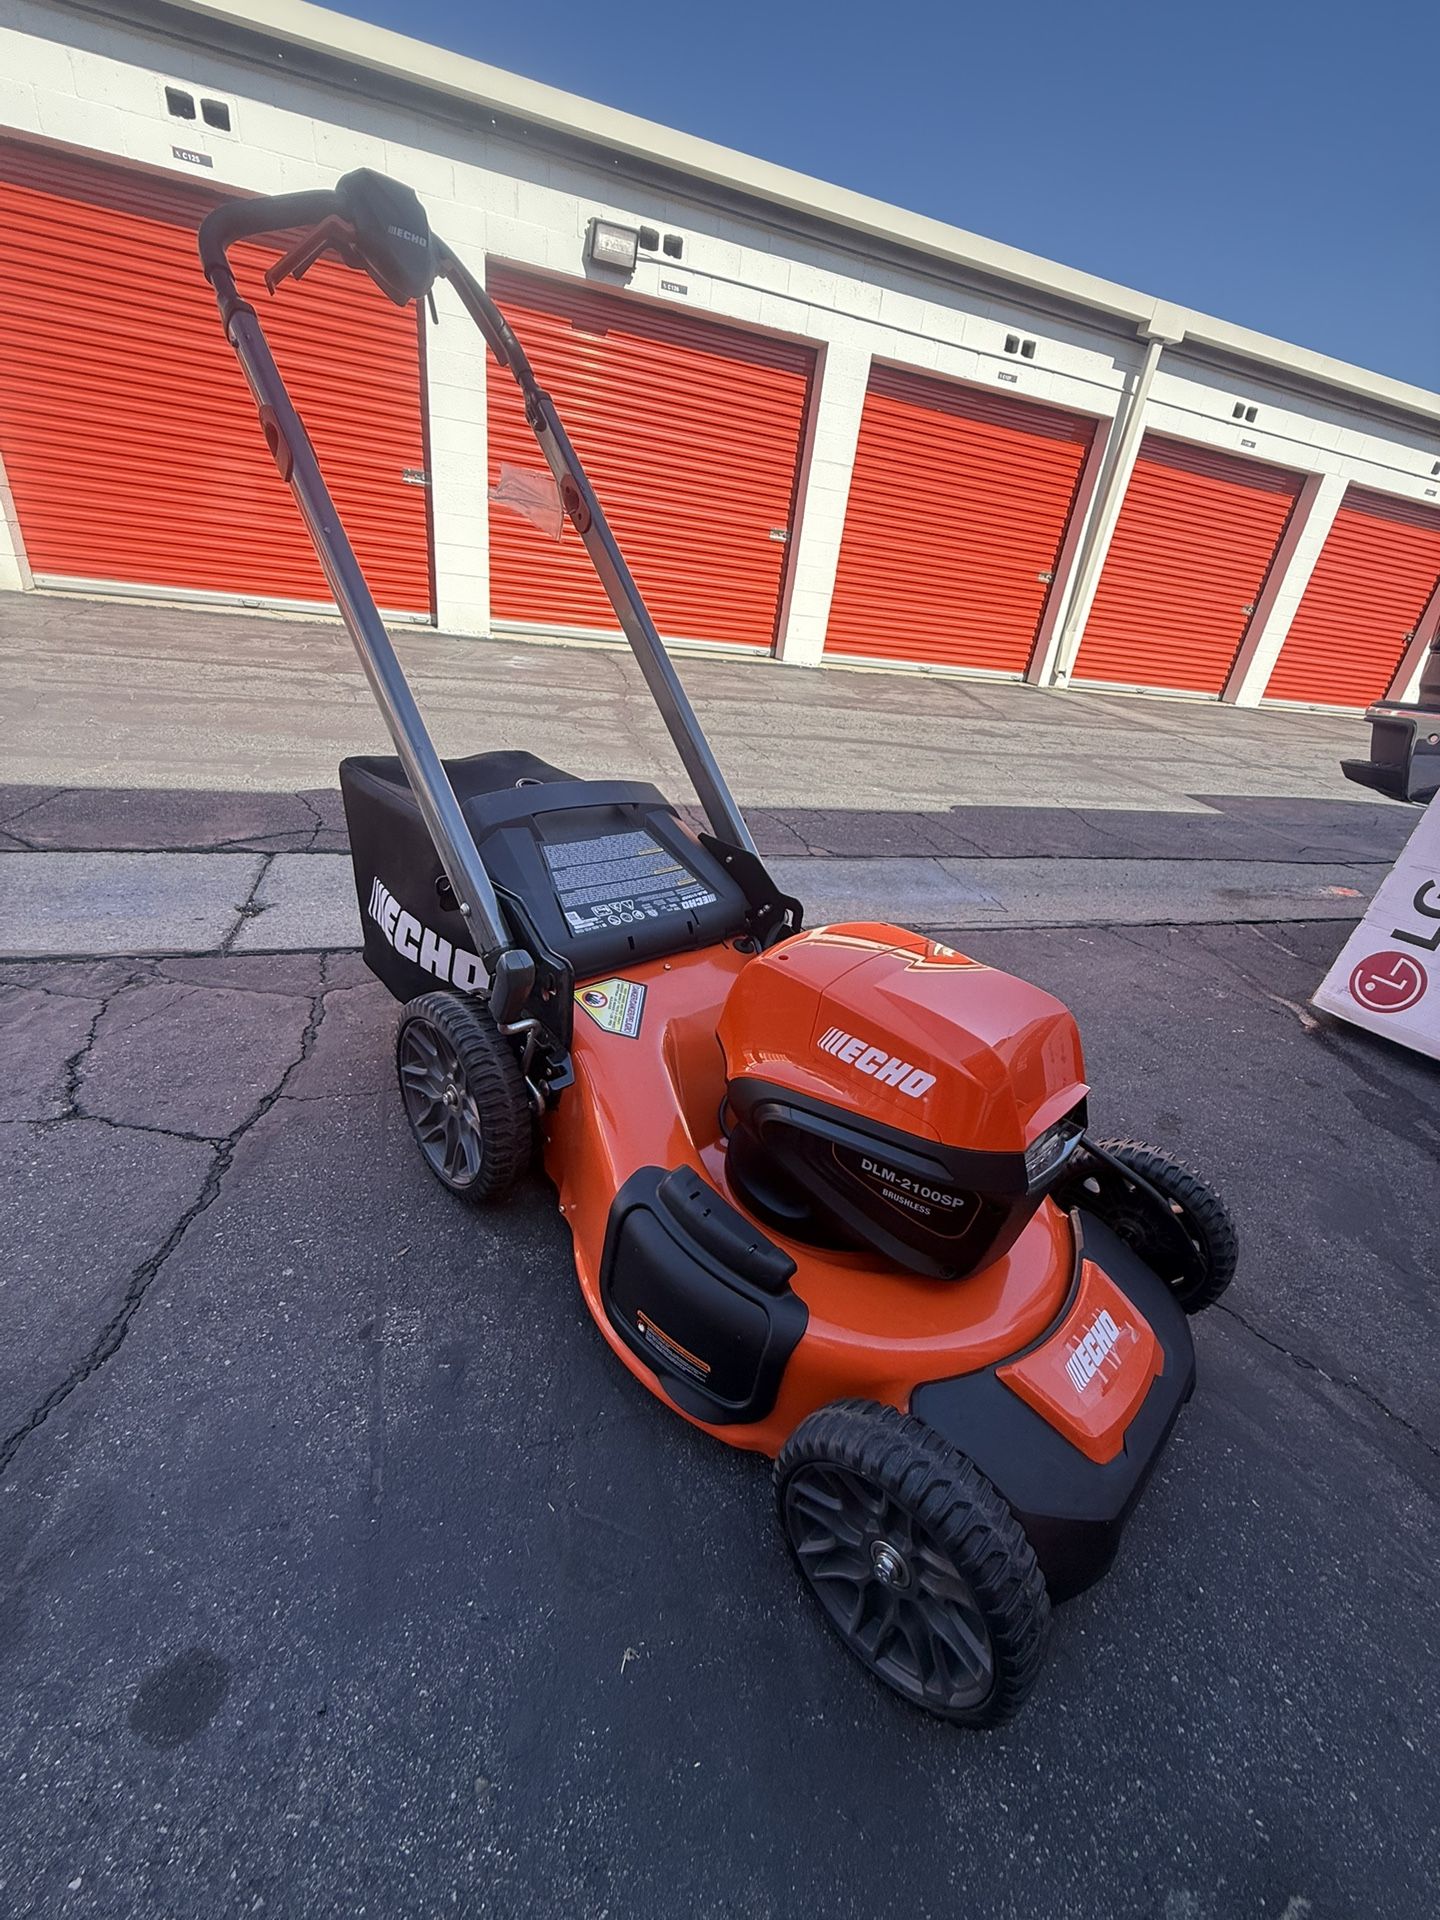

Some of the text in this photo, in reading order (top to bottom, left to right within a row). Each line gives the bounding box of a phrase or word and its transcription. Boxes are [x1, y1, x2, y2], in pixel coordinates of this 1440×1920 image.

[396, 227, 427, 248] ECHO
[381, 894, 490, 993] ECHO
[839, 1036, 938, 1099] ECHO
[860, 1157, 965, 1210] DLM-2100SP
[881, 1187, 932, 1217] BRUSHLESS
[1079, 1308, 1120, 1379] ECHO
